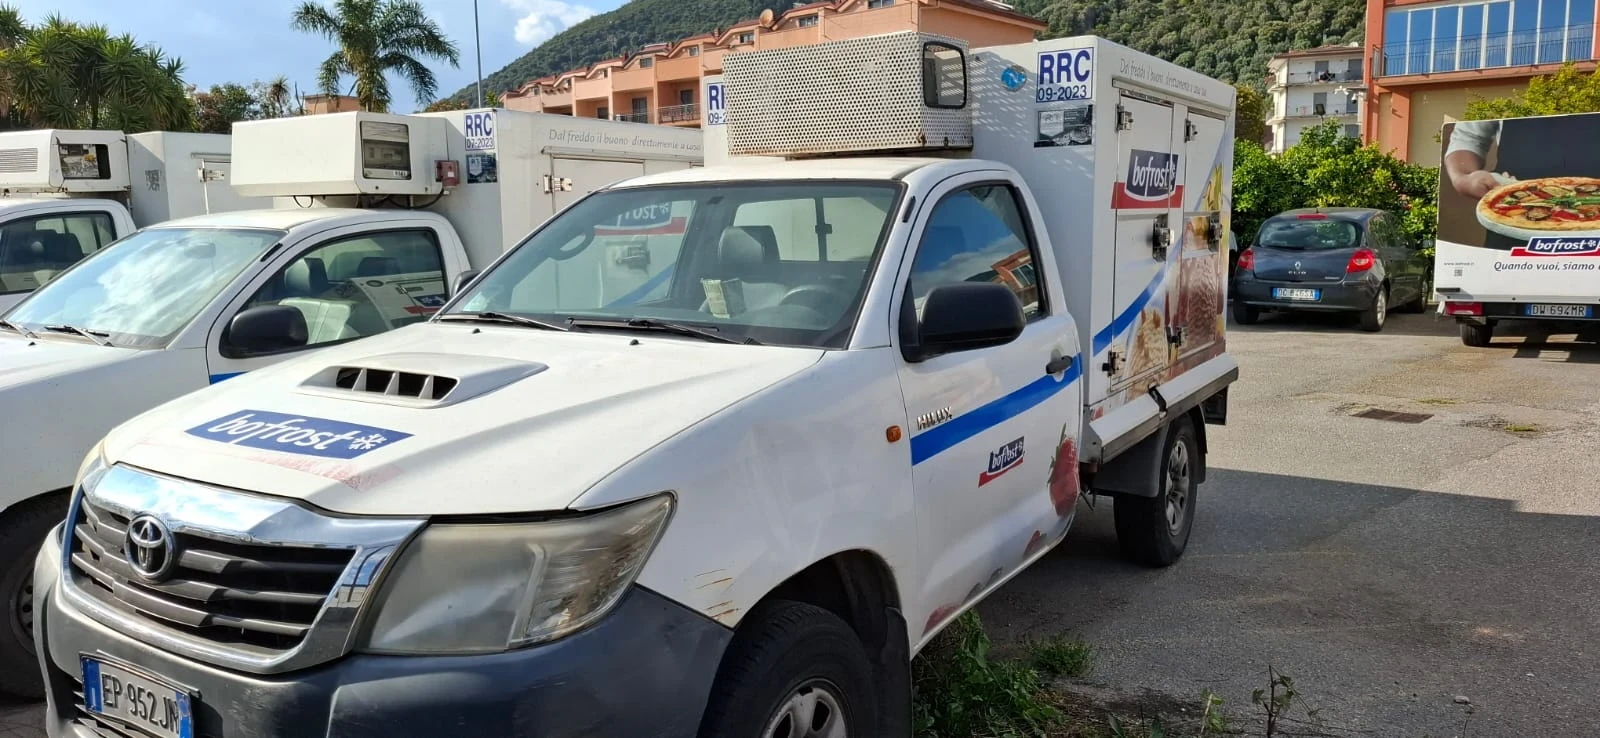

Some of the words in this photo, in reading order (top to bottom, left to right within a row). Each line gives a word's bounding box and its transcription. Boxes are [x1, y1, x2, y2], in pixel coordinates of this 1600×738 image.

[1040, 50, 1090, 85] RRC
[1038, 85, 1087, 101] 09-2023
[465, 113, 492, 137] RRC
[466, 138, 493, 149] 07-2023
[549, 129, 566, 141] Dal
[567, 130, 595, 144] freddo
[596, 133, 602, 144] il
[603, 134, 628, 146] buono
[632, 135, 679, 149] direttamente
[1132, 156, 1169, 197] bofrost
[1535, 239, 1586, 253] bofrost
[1494, 261, 1533, 272] Quando
[1536, 261, 1560, 271] vuoi,
[1562, 261, 1595, 271] siamo
[1532, 305, 1546, 315] DW
[1550, 305, 1585, 316] 694MR
[917, 406, 952, 430] HILUX
[208, 413, 360, 450] bofrost
[101, 673, 123, 709] EP
[127, 682, 180, 735] 952JN
